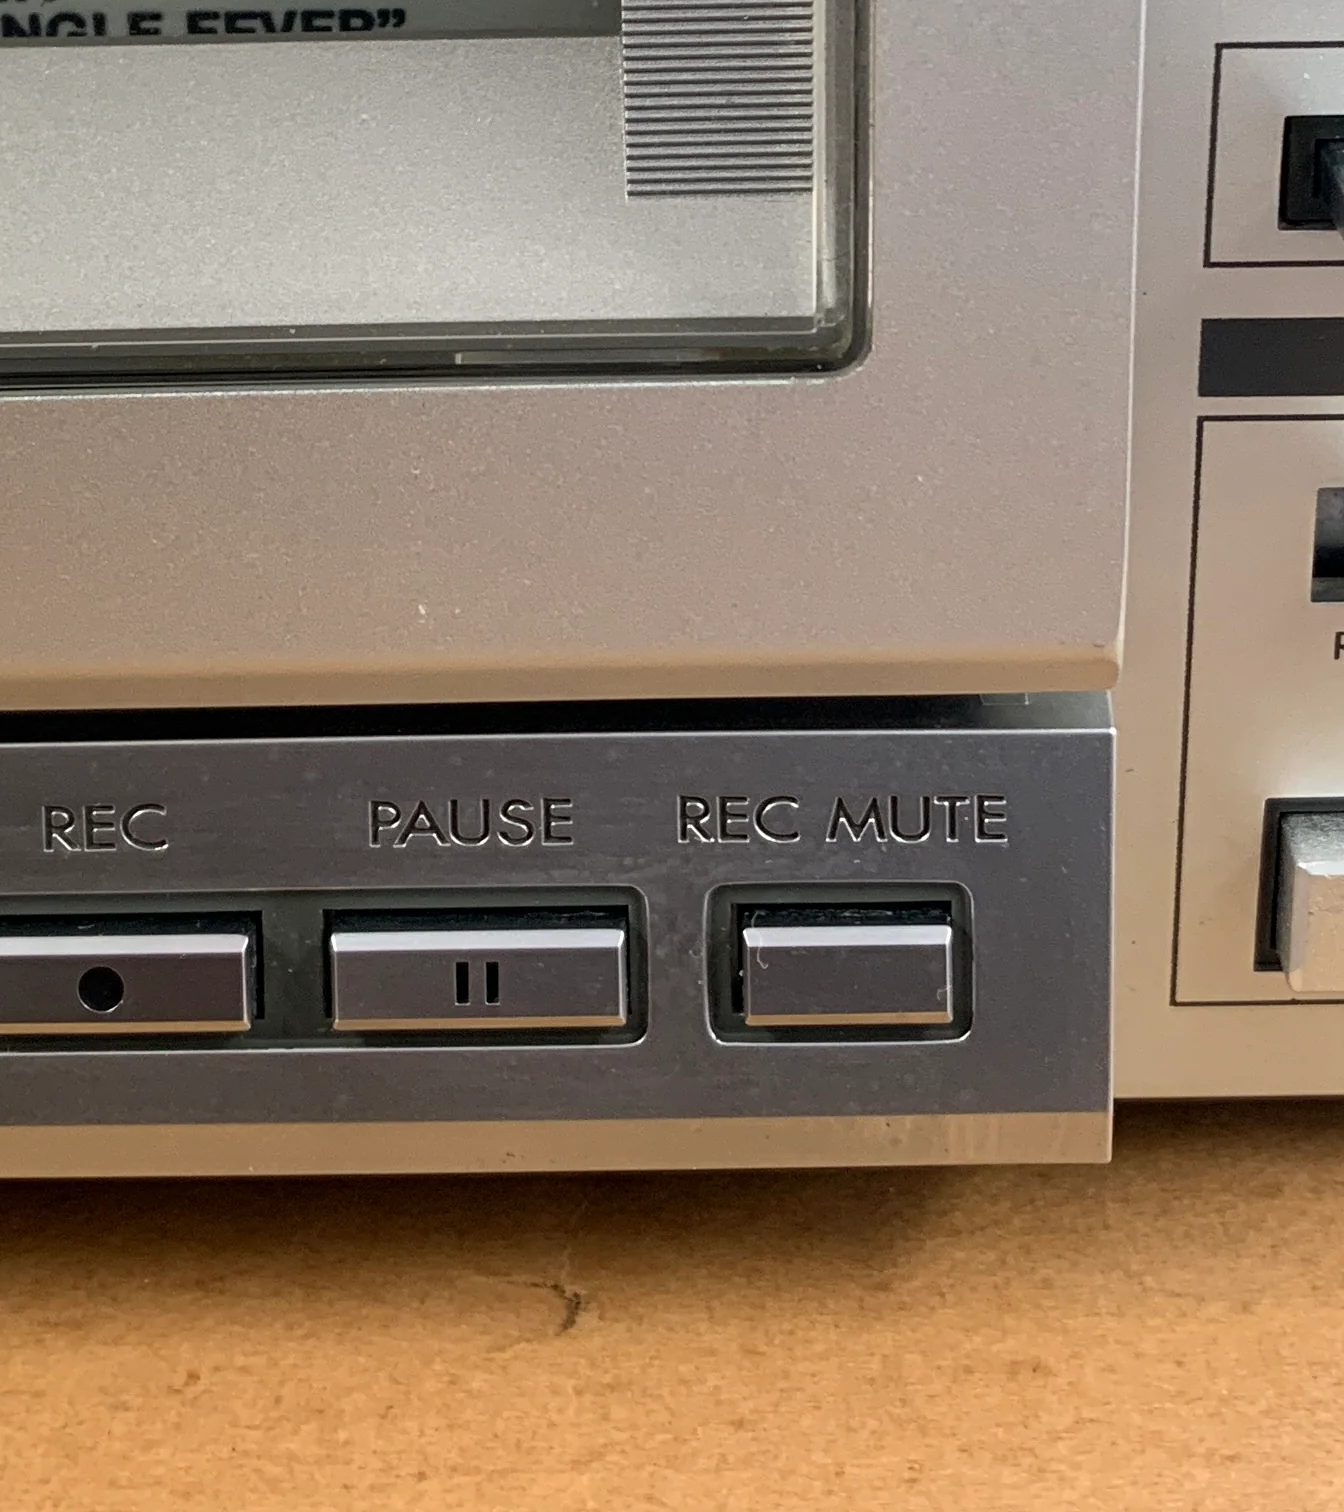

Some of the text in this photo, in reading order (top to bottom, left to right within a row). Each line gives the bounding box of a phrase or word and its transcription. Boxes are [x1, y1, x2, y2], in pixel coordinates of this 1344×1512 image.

[41, 804, 169, 851] REC
[367, 799, 575, 846] PAUSE
[675, 794, 1010, 844] REC MUTE
